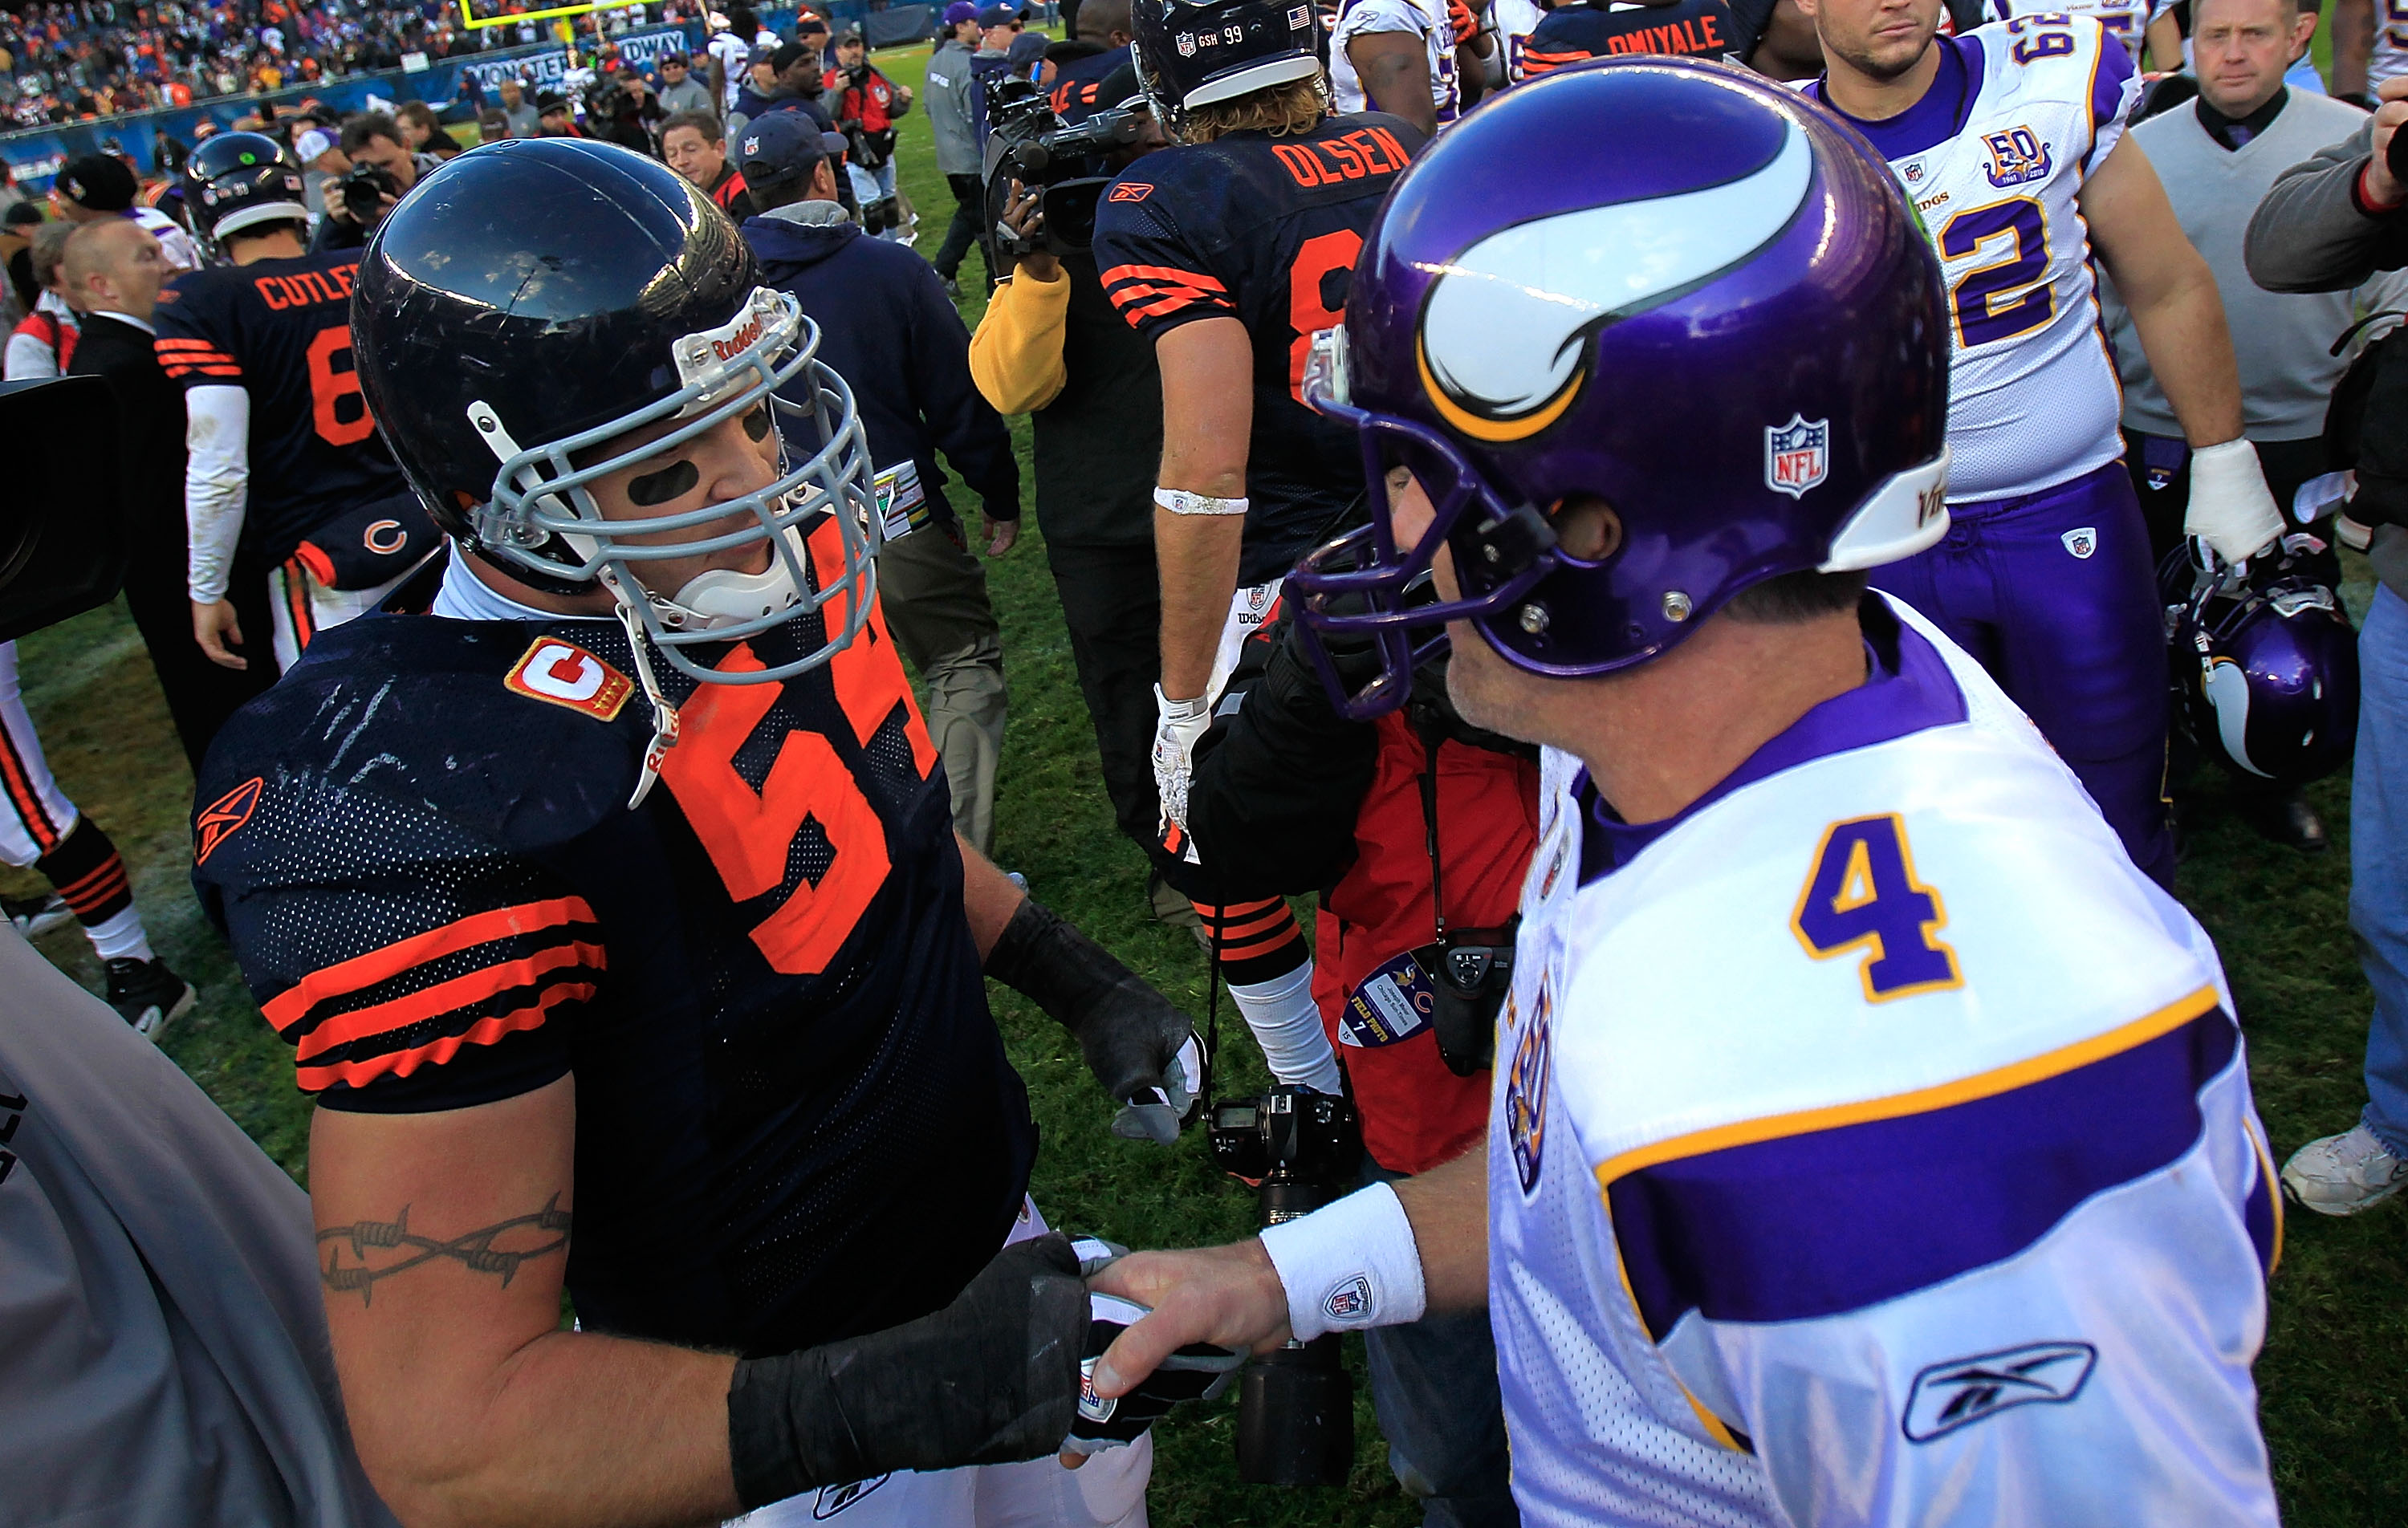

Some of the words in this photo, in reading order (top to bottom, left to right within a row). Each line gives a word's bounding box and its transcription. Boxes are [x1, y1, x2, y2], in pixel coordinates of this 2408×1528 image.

[1198, 34, 1218, 47] GSH
[1224, 25, 1243, 45] 99
[1271, 127, 1411, 187] OLSEN
[1989, 130, 2039, 167] 50
[2029, 167, 2045, 178] 2010
[1938, 195, 2056, 348] 2
[306, 324, 376, 446] 6
[1776, 450, 1821, 485] NFL
[523, 644, 605, 701] C
[1790, 812, 1966, 1004] 4
[1351, 996, 1371, 1019] FIELD
[1366, 1017, 1389, 1042] PHOTO
[1353, 1021, 1366, 1031] 7
[1334, 1295, 1348, 1314] NFL
